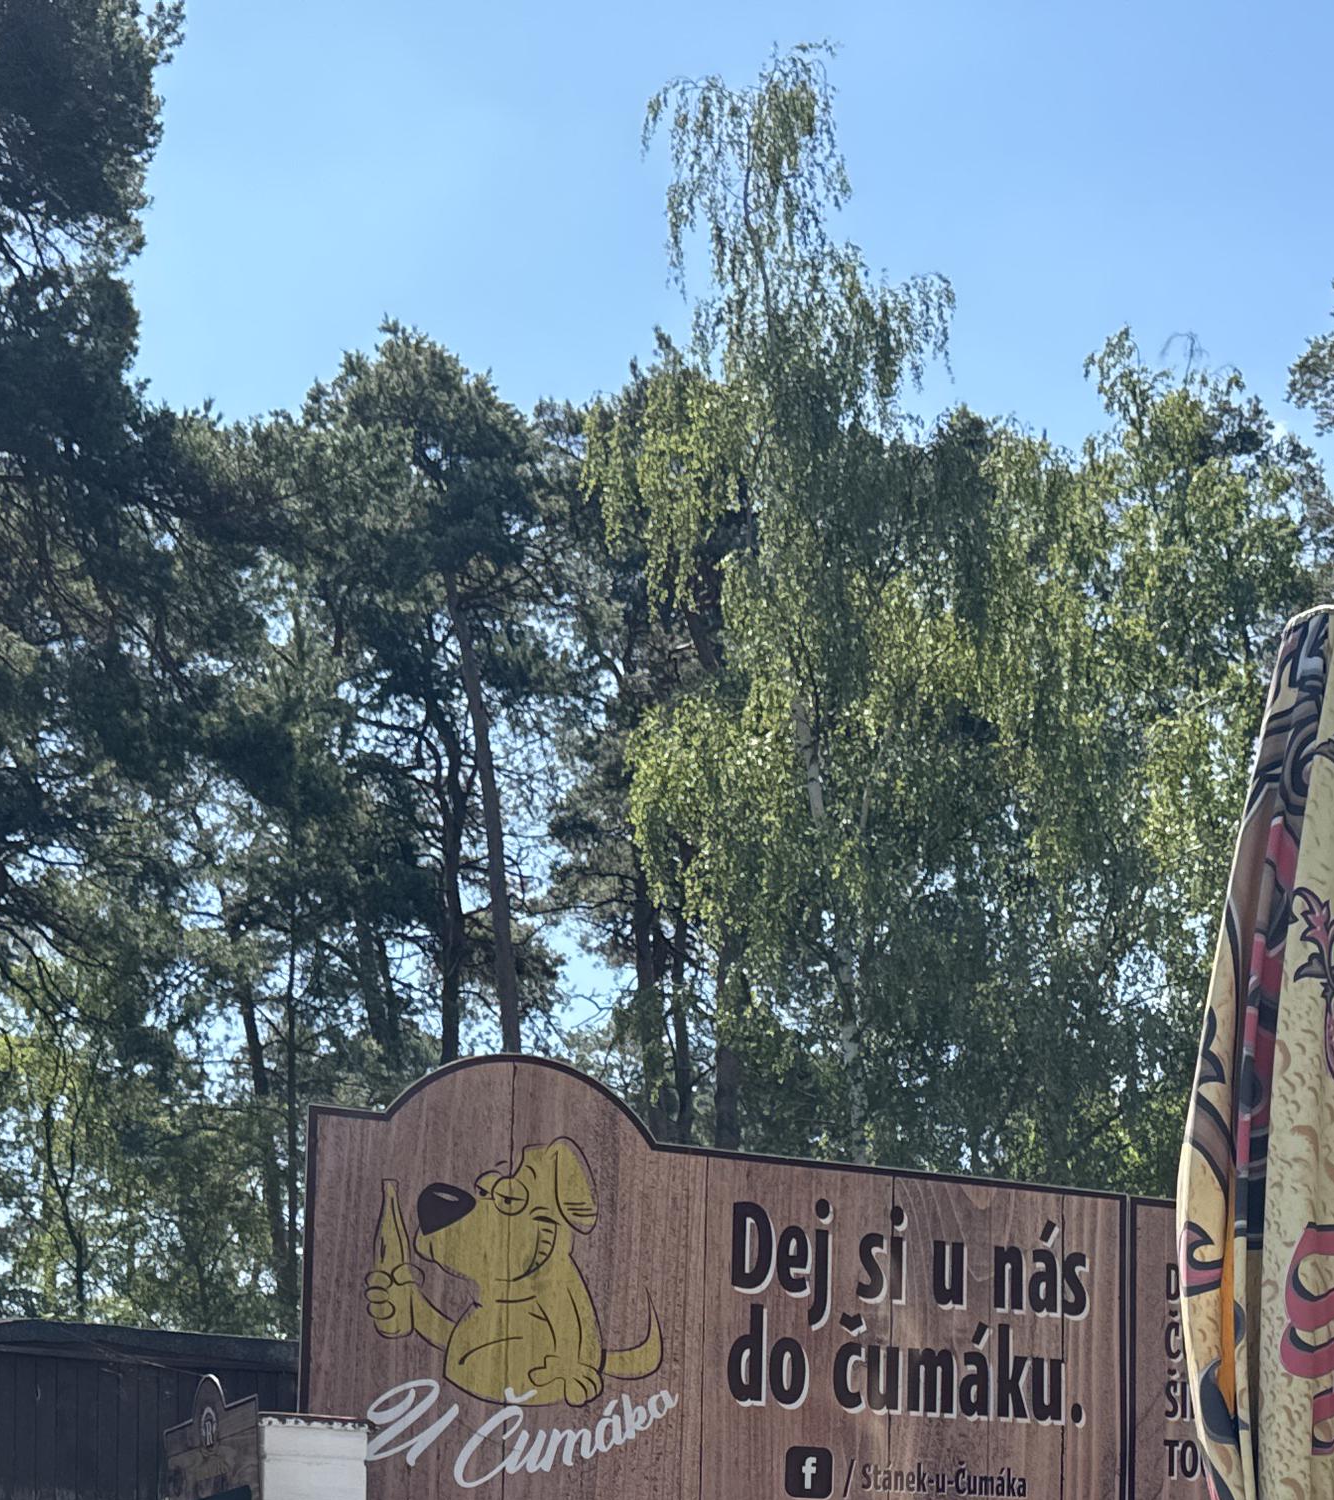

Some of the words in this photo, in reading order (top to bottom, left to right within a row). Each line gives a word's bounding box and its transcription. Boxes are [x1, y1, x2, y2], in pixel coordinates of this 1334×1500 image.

[731, 1198, 835, 1330] Dej
[855, 1205, 907, 1305] si
[932, 1239, 967, 1310] u
[994, 1219, 1090, 1321] nás
[727, 1303, 810, 1410] do
[833, 1312, 1087, 1428] čumáku.
[367, 1378, 459, 1467] U
[453, 1386, 680, 1489] Čumáka
[861, 1460, 1028, 1498] Stánek-u-Čumáka
